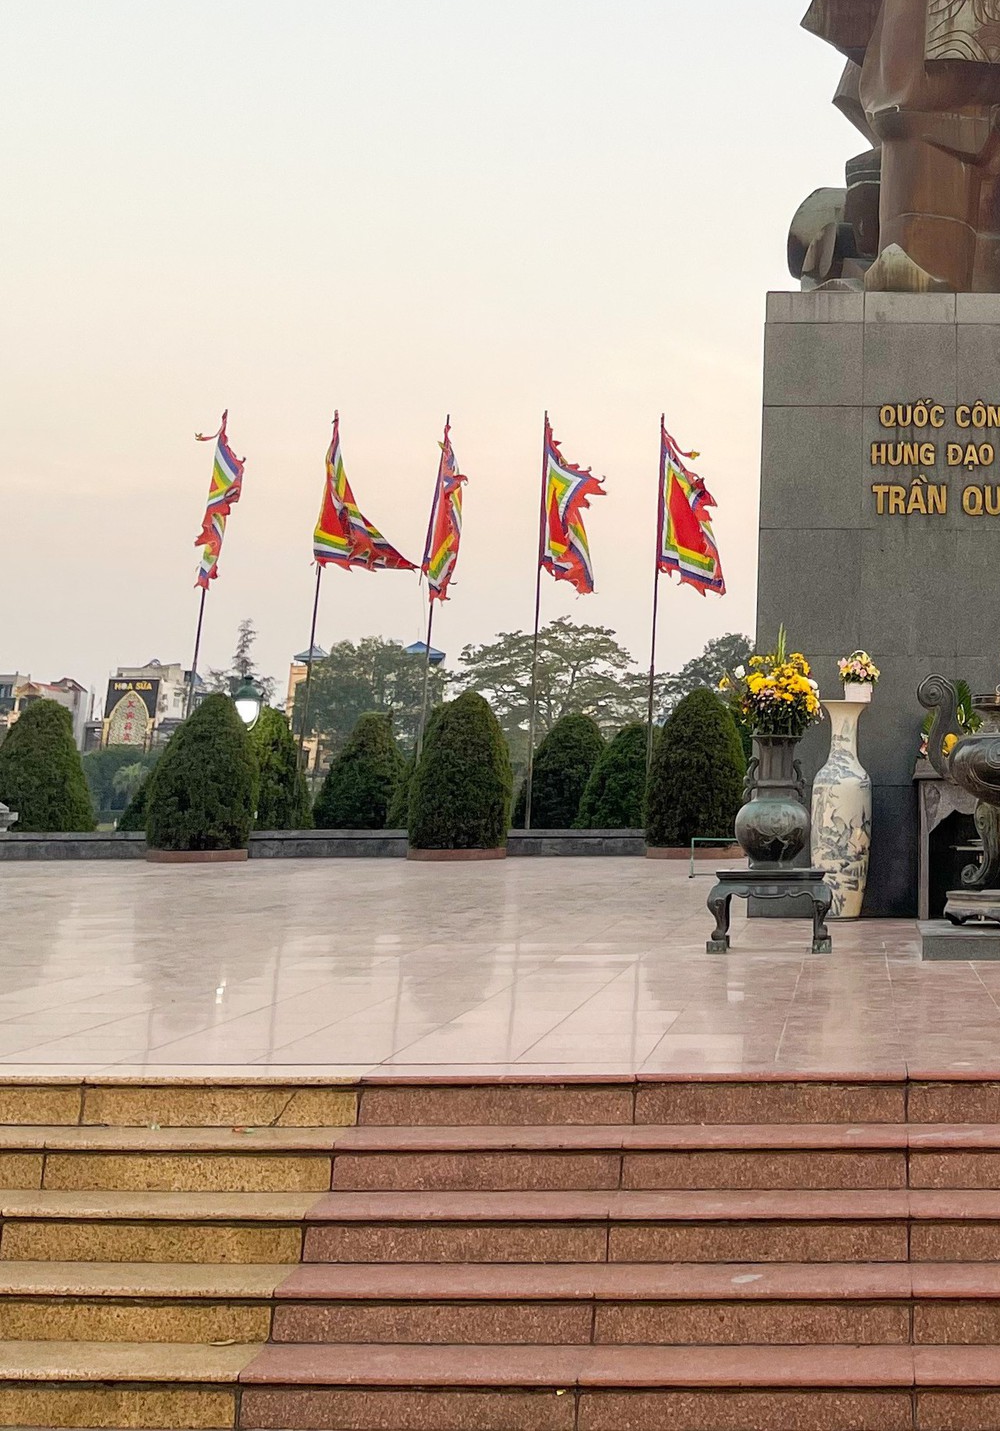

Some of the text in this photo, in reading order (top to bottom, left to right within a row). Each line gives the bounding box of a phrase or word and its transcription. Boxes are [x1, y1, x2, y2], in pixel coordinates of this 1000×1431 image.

[879, 399, 945, 428] QUỐC
[871, 441, 935, 466] HƯNG
[946, 442, 994, 471] ĐẠO
[872, 474, 947, 514] TRẦN
